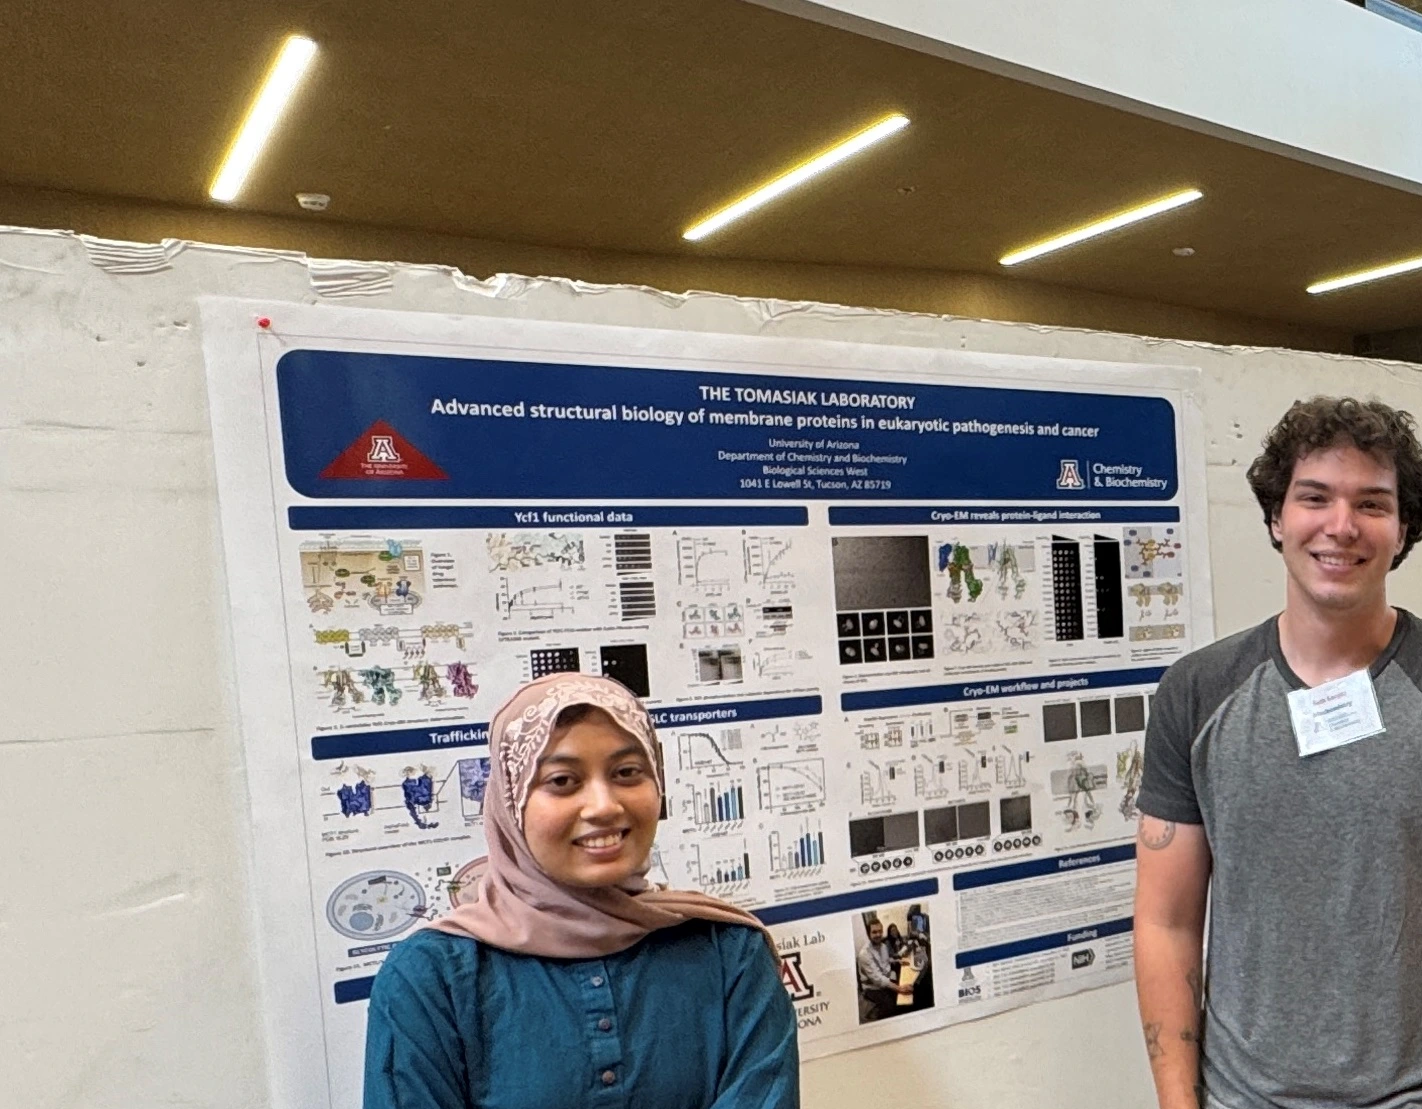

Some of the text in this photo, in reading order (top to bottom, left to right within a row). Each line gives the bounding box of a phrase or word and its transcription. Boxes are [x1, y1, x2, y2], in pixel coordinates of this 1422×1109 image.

[699, 385, 916, 410] THE TOMASIAK LABORATORY
[431, 398, 1100, 438] Advanced structural biology of membrane proteins in eukaryotic pathogenesis and cancer
[768, 438, 860, 450] University of Arizona
[718, 450, 908, 466] Department of Chemistry and Biochemistry
[762, 465, 868, 477] Biological Sciences West
[1093, 463, 1143, 477] Chemistry
[740, 478, 763, 489] 1041
[764, 479, 771, 489] E
[772, 479, 801, 489] Lowell
[816, 479, 849, 490] Tucson,
[850, 480, 863, 490] AZ
[864, 480, 892, 490] 85719
[1093, 476, 1168, 490] & Biochemistry
[514, 511, 634, 523] Ycf1 functional data
[931, 510, 1101, 521] Cryo-EM reveals protein-ligand interaction
[963, 678, 1089, 697] Cryo-EM workflow and projects
[669, 709, 737, 723] transporters
[429, 728, 489, 744] Traffickin
[1058, 855, 1101, 869] References
[776, 930, 826, 951] siak Lab
[1067, 929, 1098, 943] Funding
[798, 1000, 830, 1017] ERSITY
[797, 1015, 823, 1030] ONA
